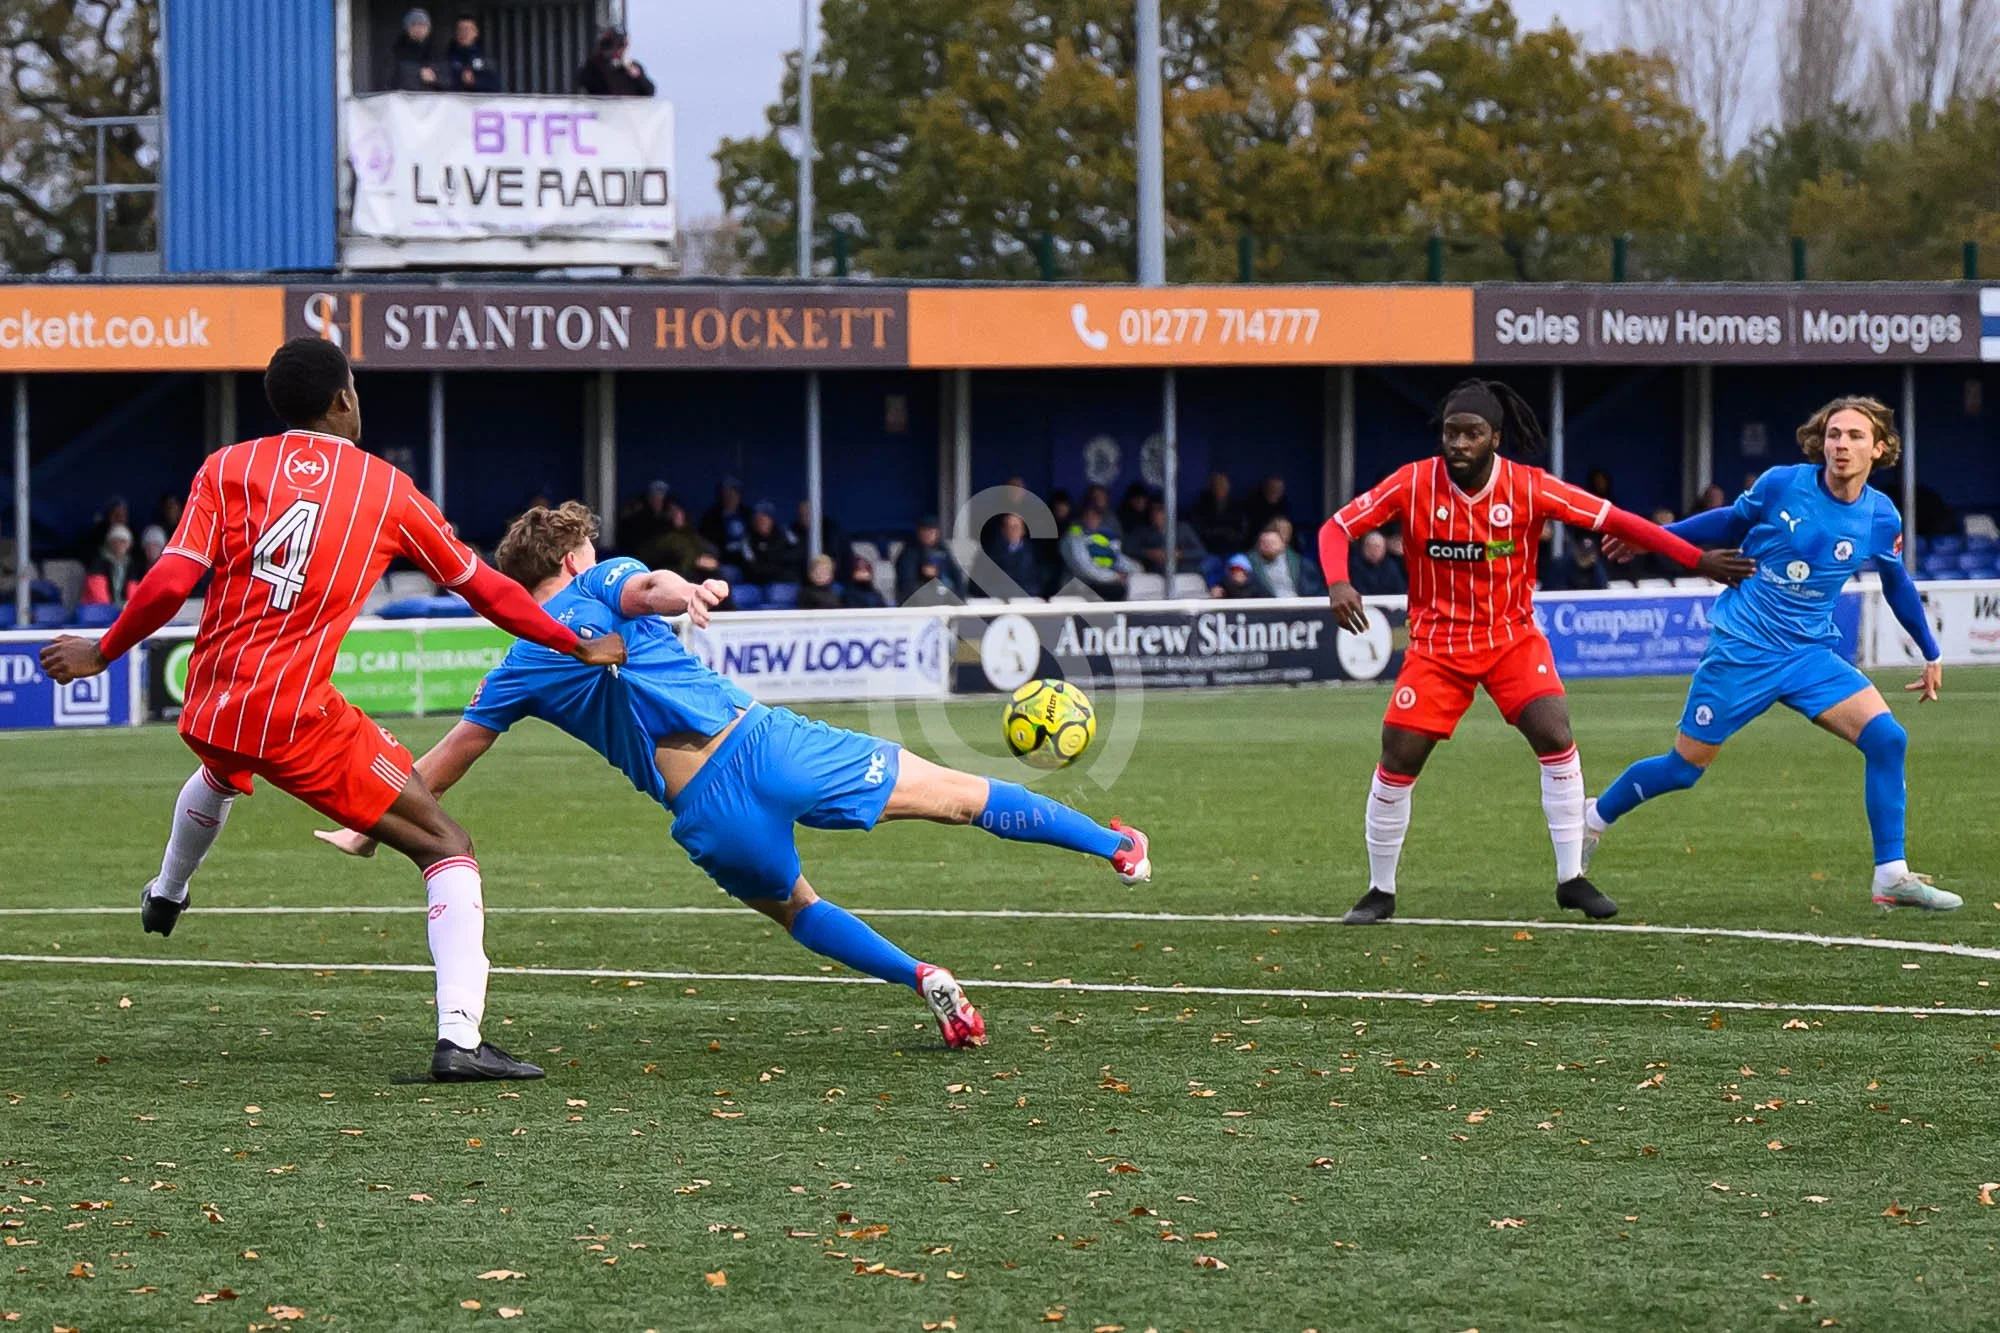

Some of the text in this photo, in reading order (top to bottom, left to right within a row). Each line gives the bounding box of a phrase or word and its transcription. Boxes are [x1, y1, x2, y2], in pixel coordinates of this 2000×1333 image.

[472, 109, 598, 155] BTFC
[537, 167, 668, 207] RADIO
[0, 308, 209, 348] ckett.co.uk
[384, 304, 896, 351] STANTON HOCKETT
[1118, 307, 1321, 345] 01277 714777
[1495, 307, 1580, 345] Sales
[1602, 308, 1782, 346] New Homes
[1803, 309, 1962, 354] Mortgages
[252, 499, 320, 611] 4
[1054, 612, 1323, 656] Andrew Skinner
[1554, 603, 1669, 640] Company
[723, 636, 910, 675] NEW LODGE
